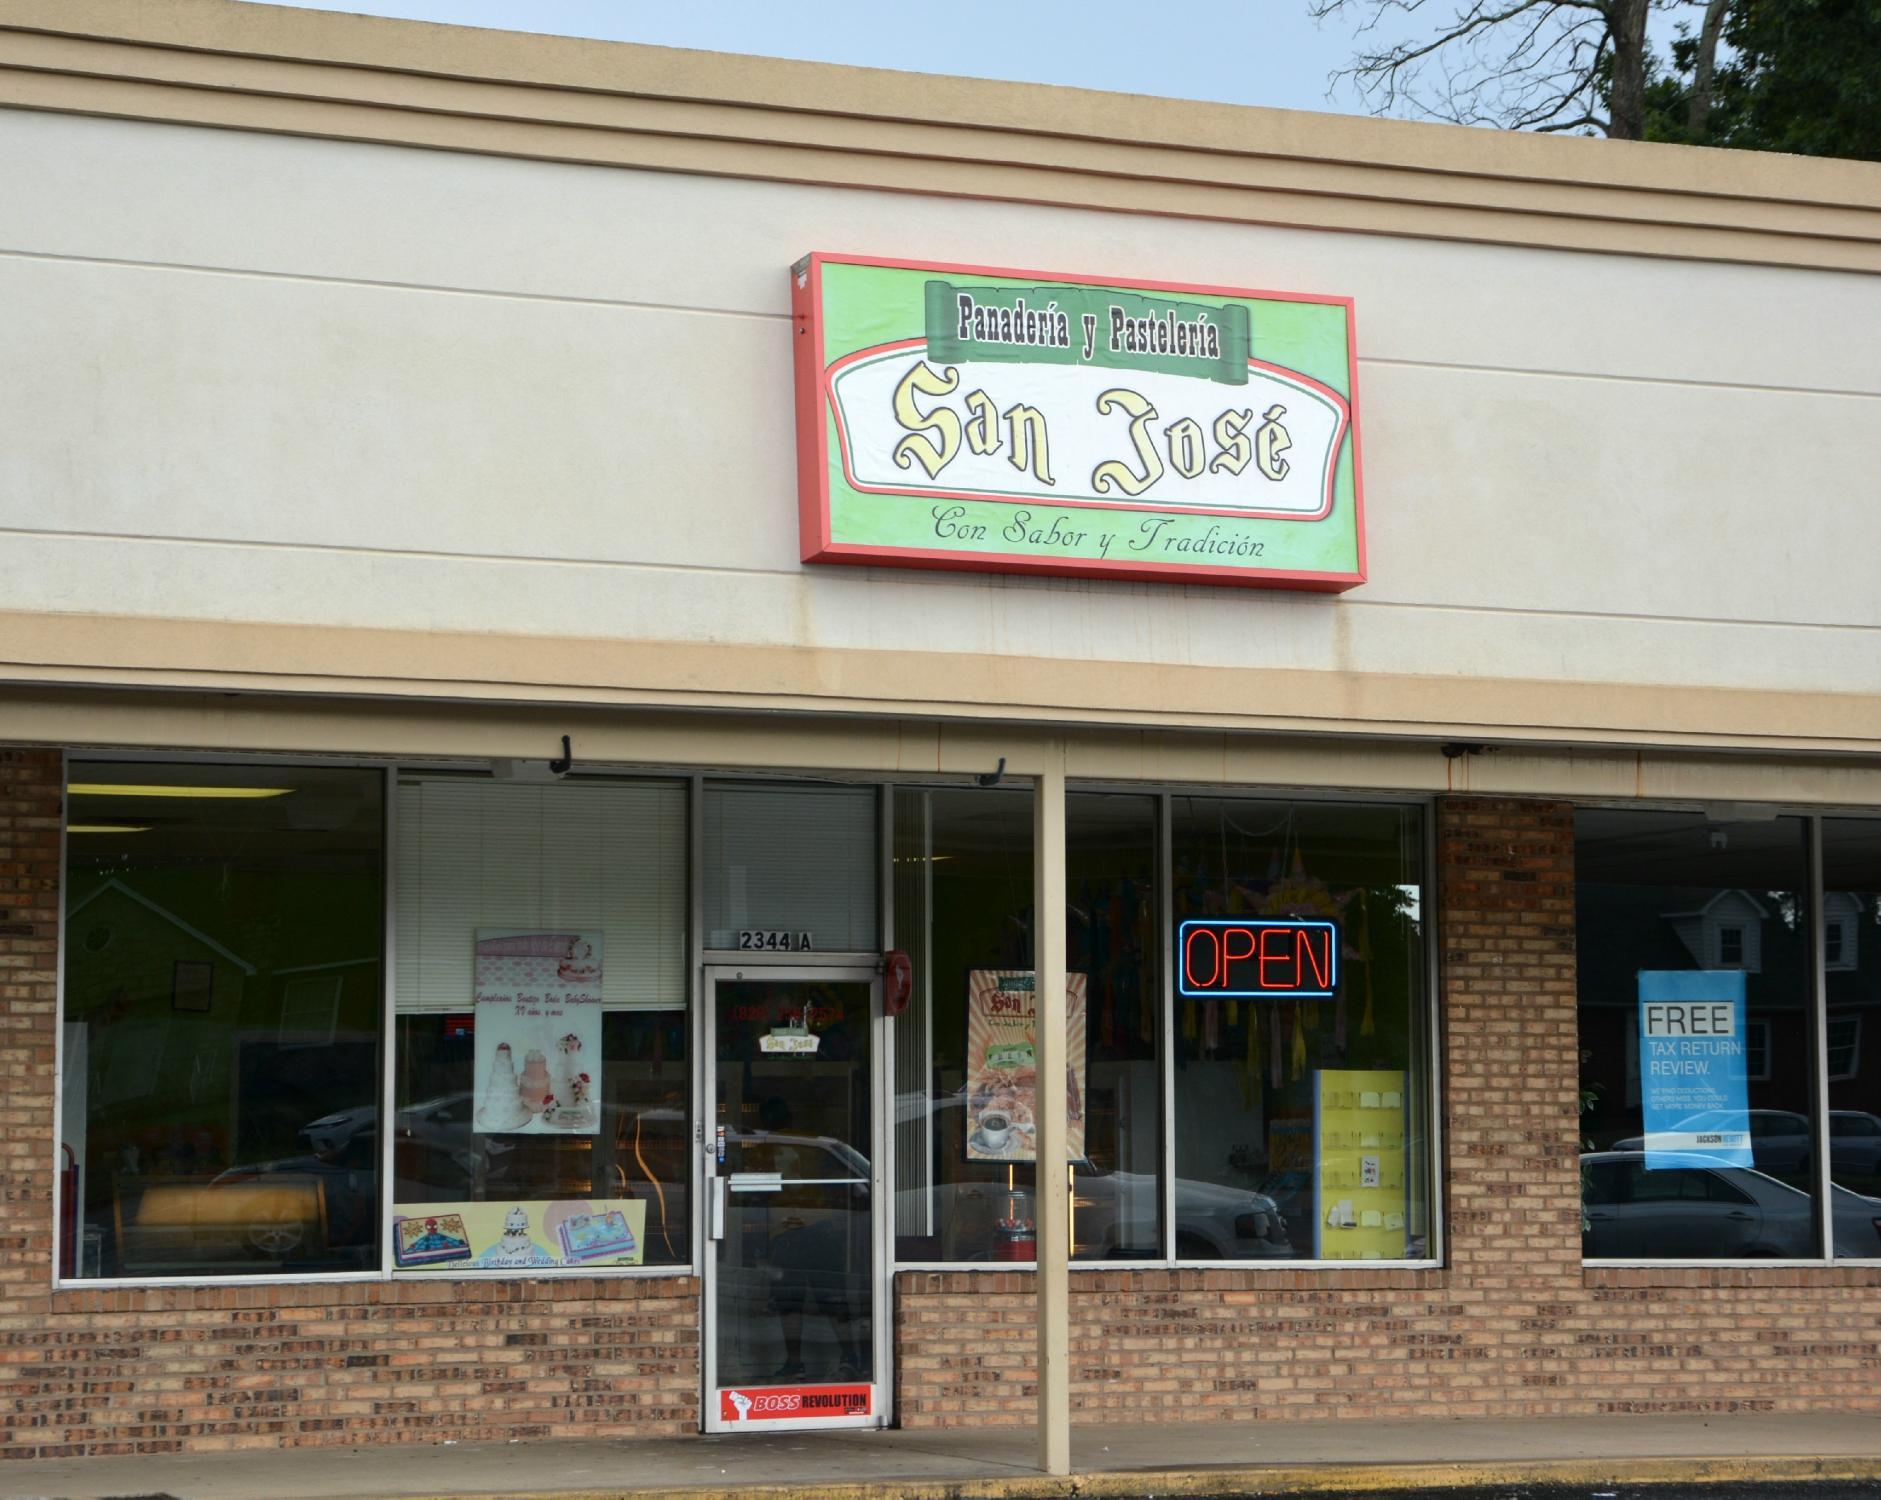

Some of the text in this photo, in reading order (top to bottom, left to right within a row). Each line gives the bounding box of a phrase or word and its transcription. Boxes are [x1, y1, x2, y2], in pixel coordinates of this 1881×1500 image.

[958, 293, 1221, 360] Panadería y Pastelería
[892, 361, 1293, 496] San José
[932, 506, 1265, 558] Con Sabor y Tradición
[741, 931, 811, 950] 2344 A
[1185, 928, 1330, 989] OPEN
[1647, 1005, 1730, 1034] FREE
[1649, 1041, 1741, 1055] TAX RETURN
[1650, 1061, 1710, 1075] REVIEW.
[754, 1393, 866, 1411] BOSS REVOLUTION
